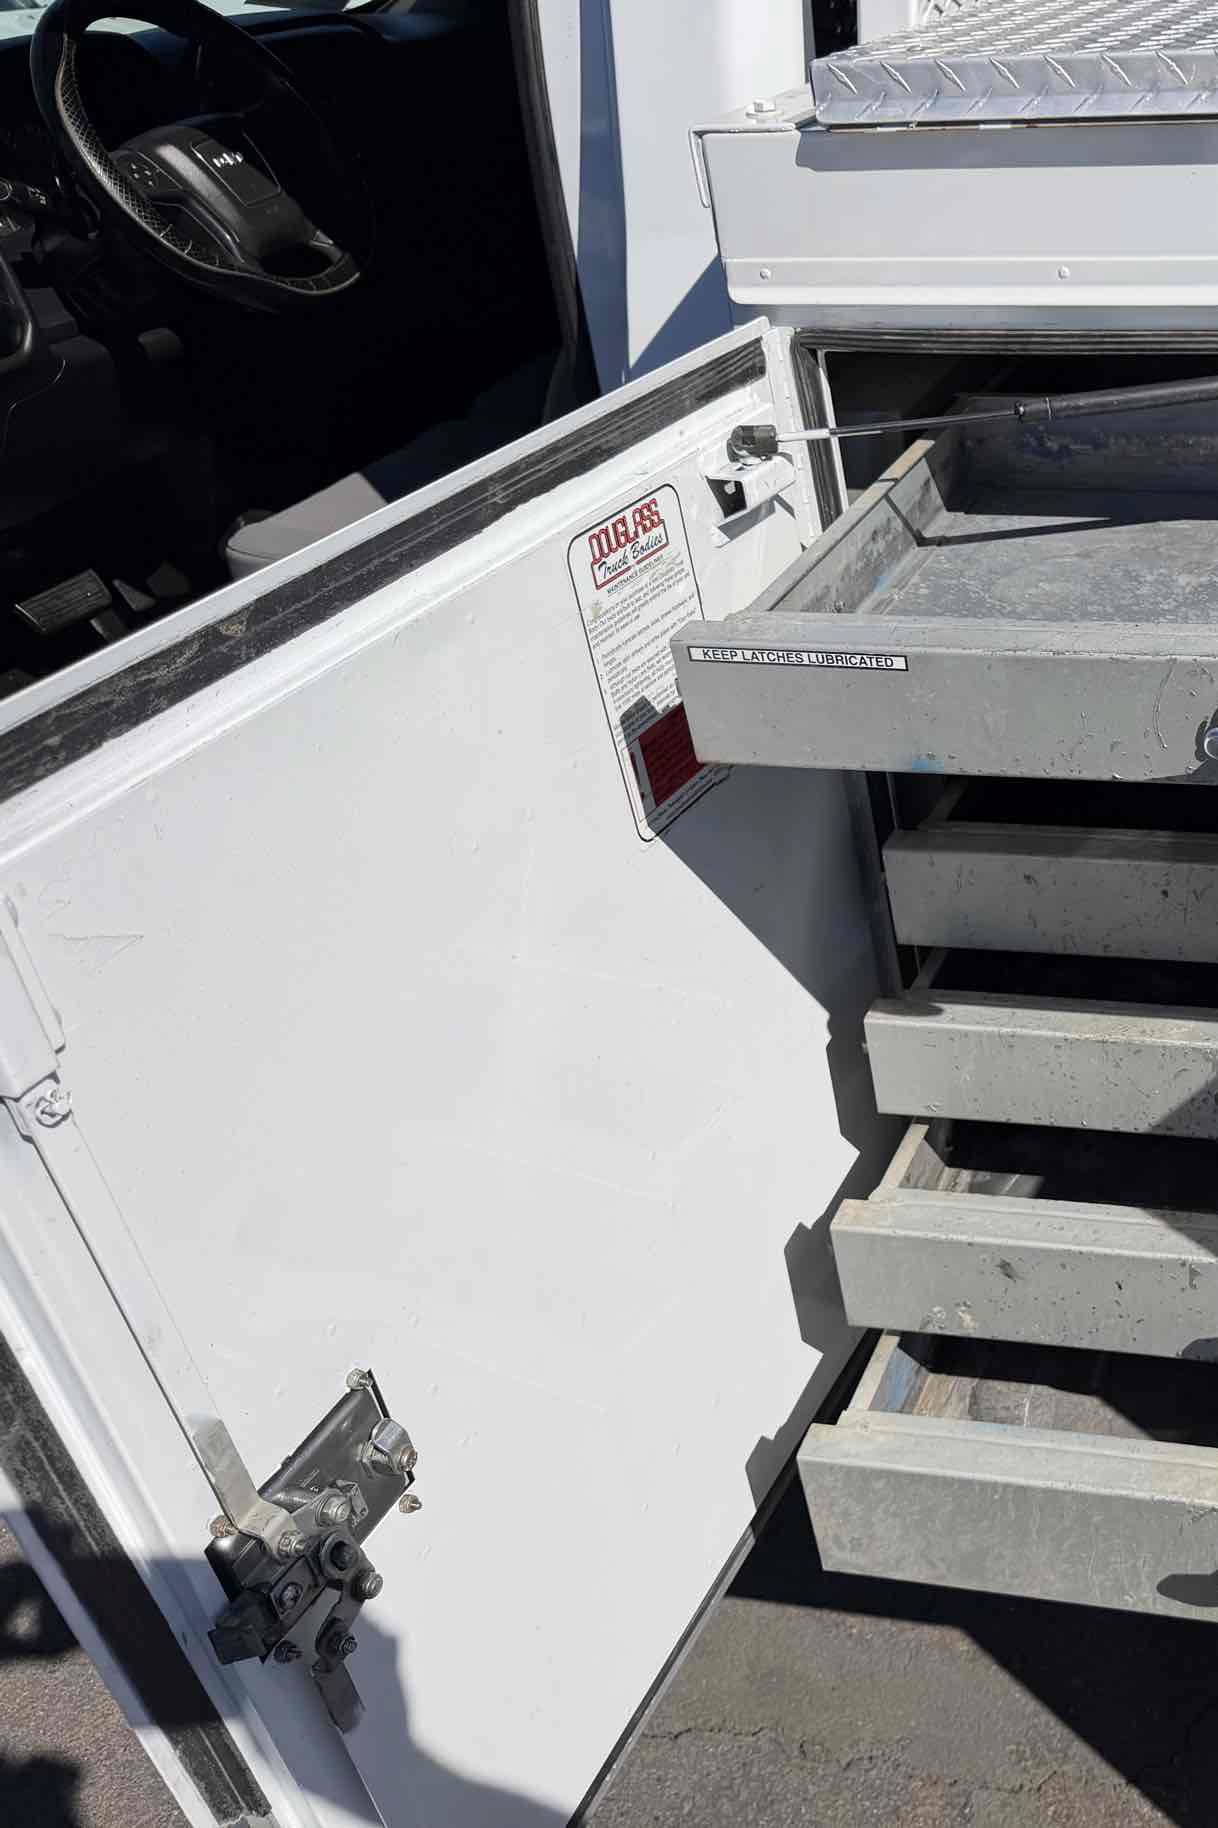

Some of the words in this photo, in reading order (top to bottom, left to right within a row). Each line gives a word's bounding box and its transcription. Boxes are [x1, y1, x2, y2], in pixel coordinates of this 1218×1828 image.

[588, 498, 661, 565] DOUGLASS
[598, 549, 629, 579] Truck
[630, 532, 664, 560] Bodies
[702, 649, 738, 661] KEEP
[742, 651, 804, 664] LATCHES
[808, 655, 894, 668] LUBRICATED
